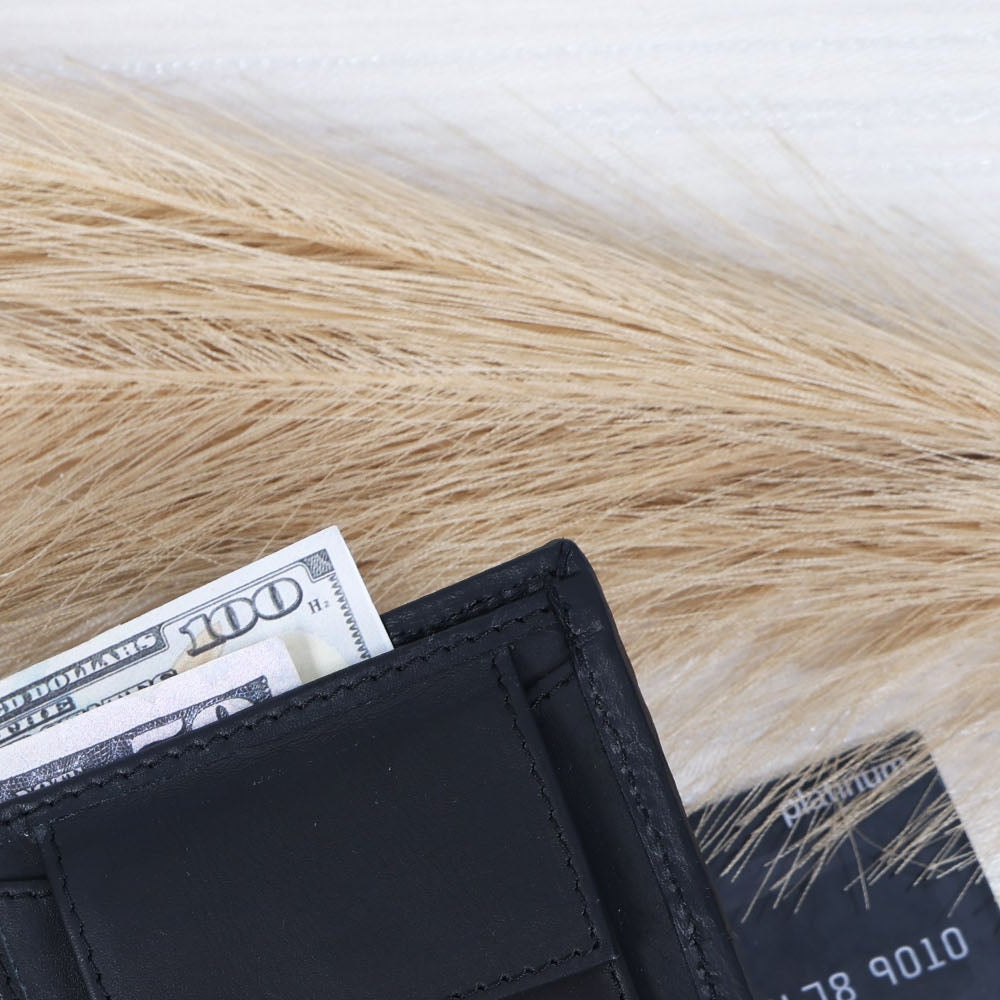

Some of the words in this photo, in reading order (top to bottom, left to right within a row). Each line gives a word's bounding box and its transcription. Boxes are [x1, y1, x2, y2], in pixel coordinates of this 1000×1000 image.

[179, 577, 303, 657] 100
[28, 632, 158, 697] DOLLARS
[868, 926, 969, 985] 9010
